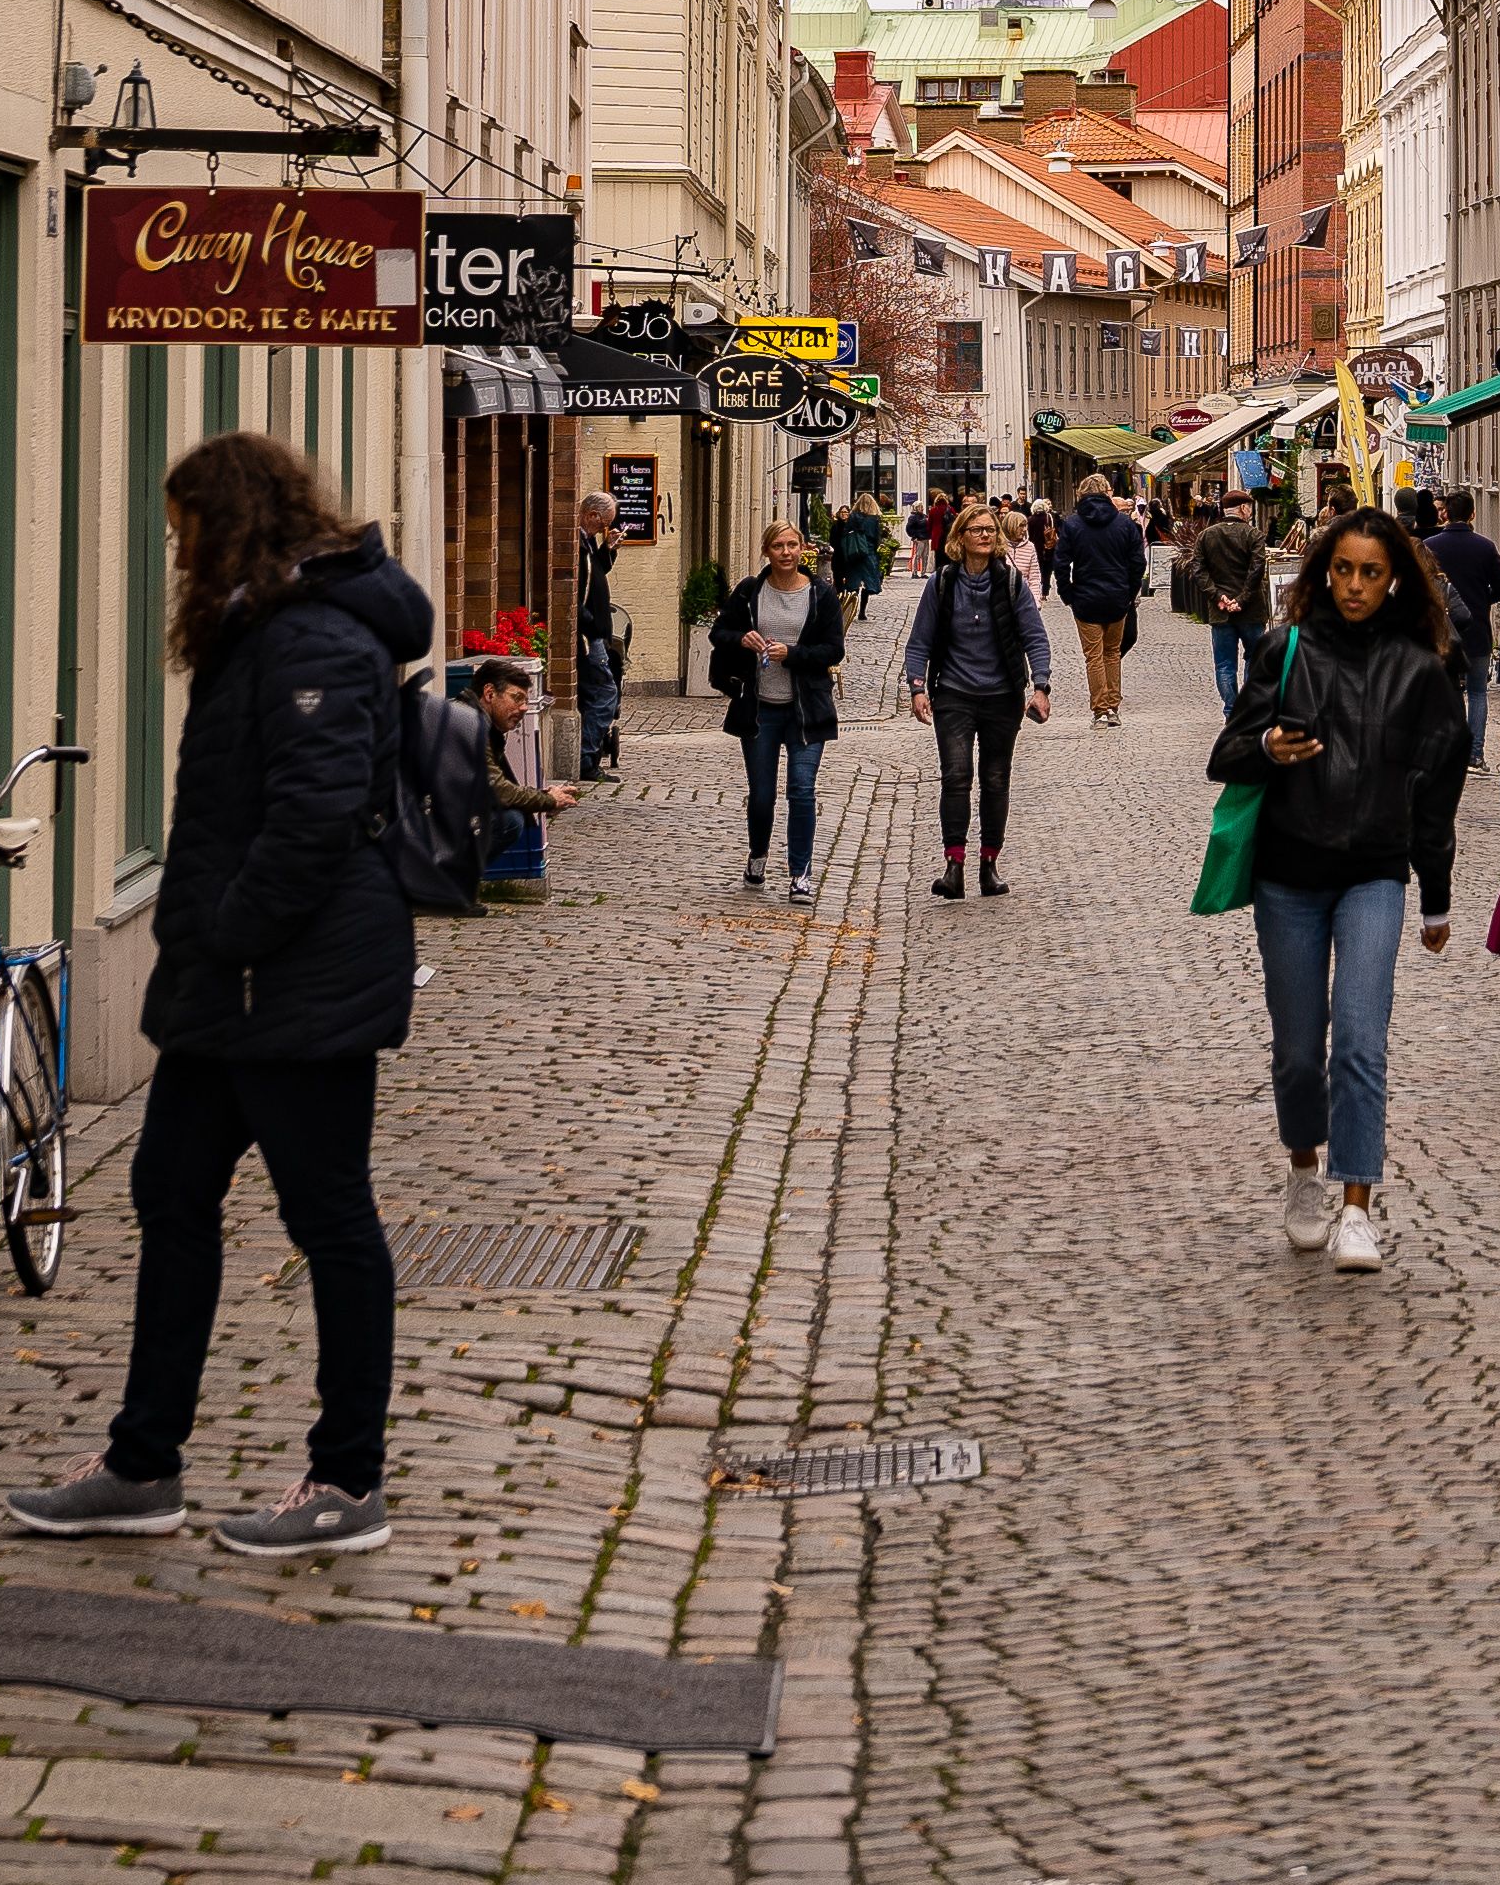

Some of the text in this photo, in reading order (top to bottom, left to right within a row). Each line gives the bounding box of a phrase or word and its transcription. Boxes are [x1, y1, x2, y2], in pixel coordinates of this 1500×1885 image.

[133, 200, 376, 296] Curry House
[423, 234, 535, 296] ter
[106, 306, 398, 334] KRYDDOR, TE & KAFFE
[716, 364, 784, 387] CAFÉ
[718, 388, 781, 408] HEBBE LELLE
